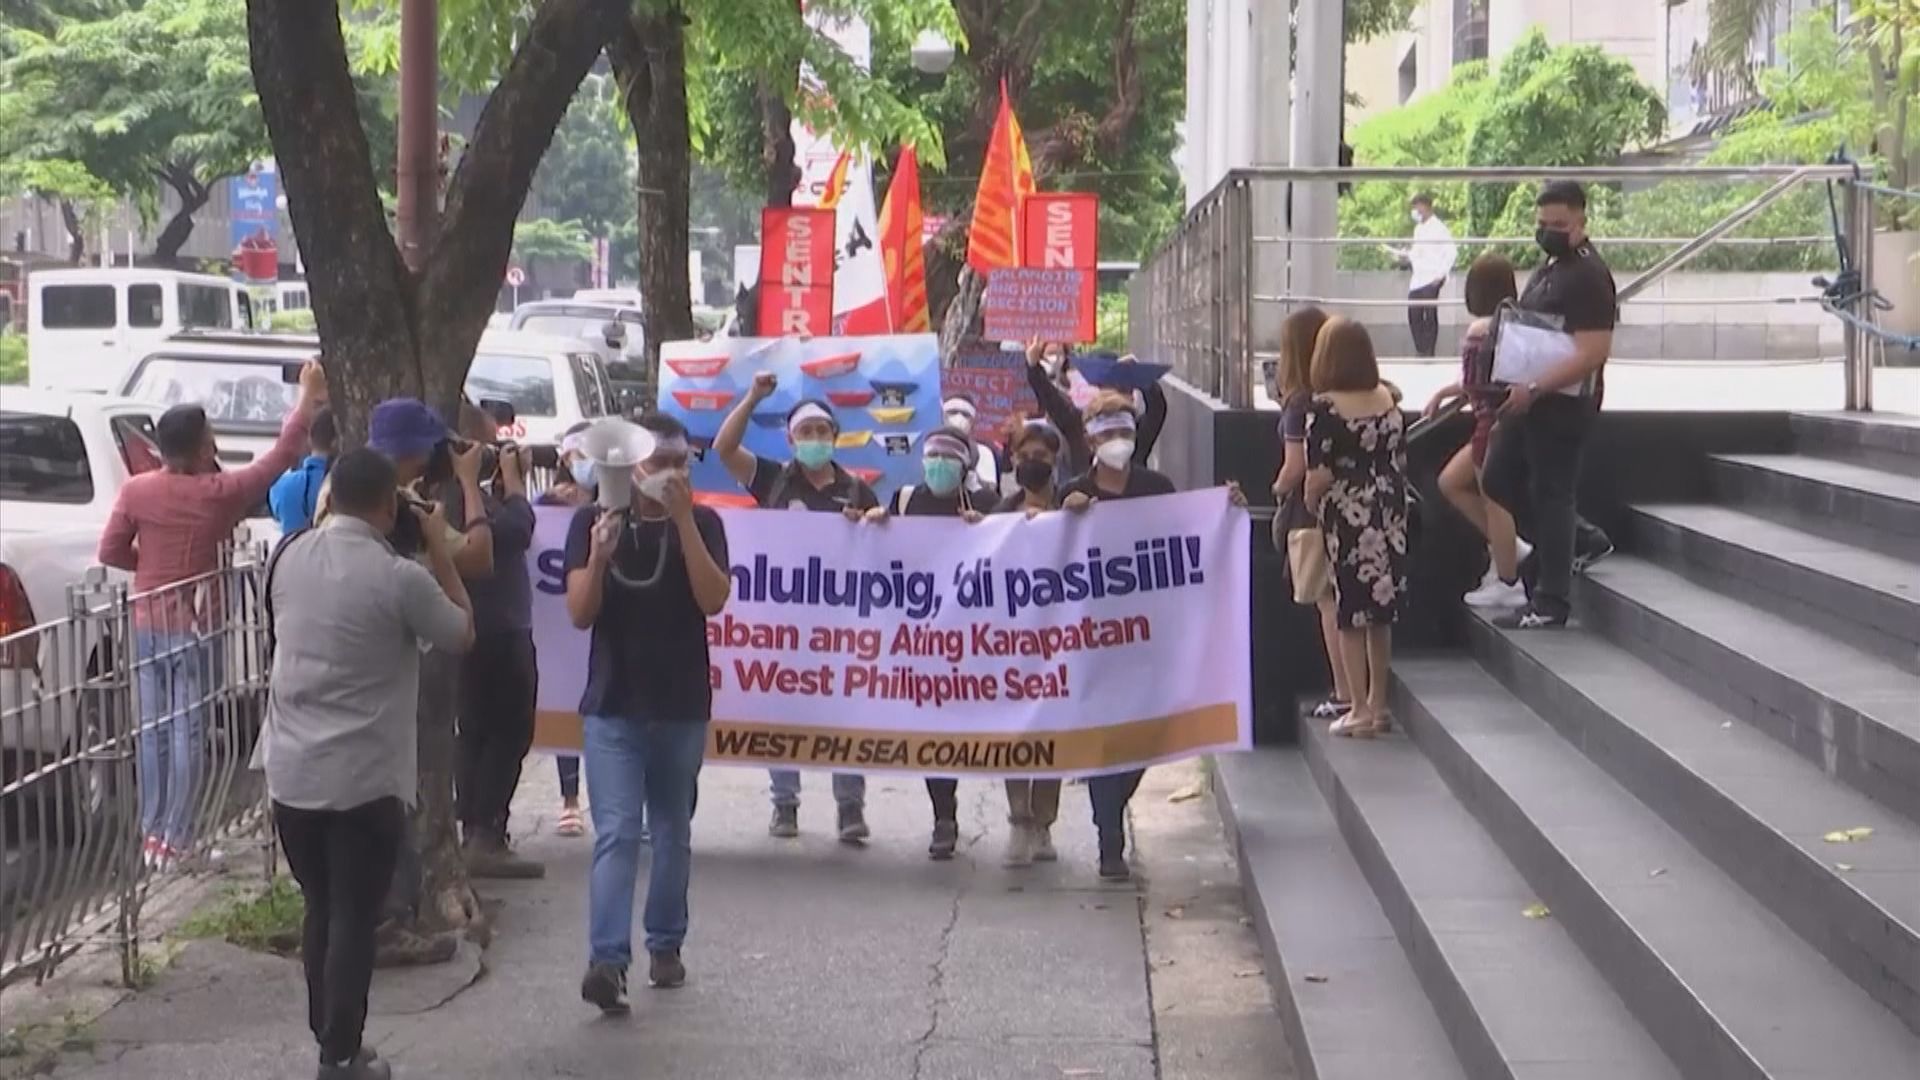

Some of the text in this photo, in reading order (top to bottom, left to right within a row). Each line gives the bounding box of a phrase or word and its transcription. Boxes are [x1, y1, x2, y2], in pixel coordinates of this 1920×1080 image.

[1005, 536, 1204, 618] pasisiil!
[809, 626, 882, 661] ang
[889, 622, 964, 663] Ating
[971, 615, 1150, 661] Karapatan
[734, 659, 834, 696] West
[844, 665, 998, 707] Philippine
[1004, 663, 1069, 701] Sea!
[715, 729, 1055, 768] WEST PH SEA COALITION
